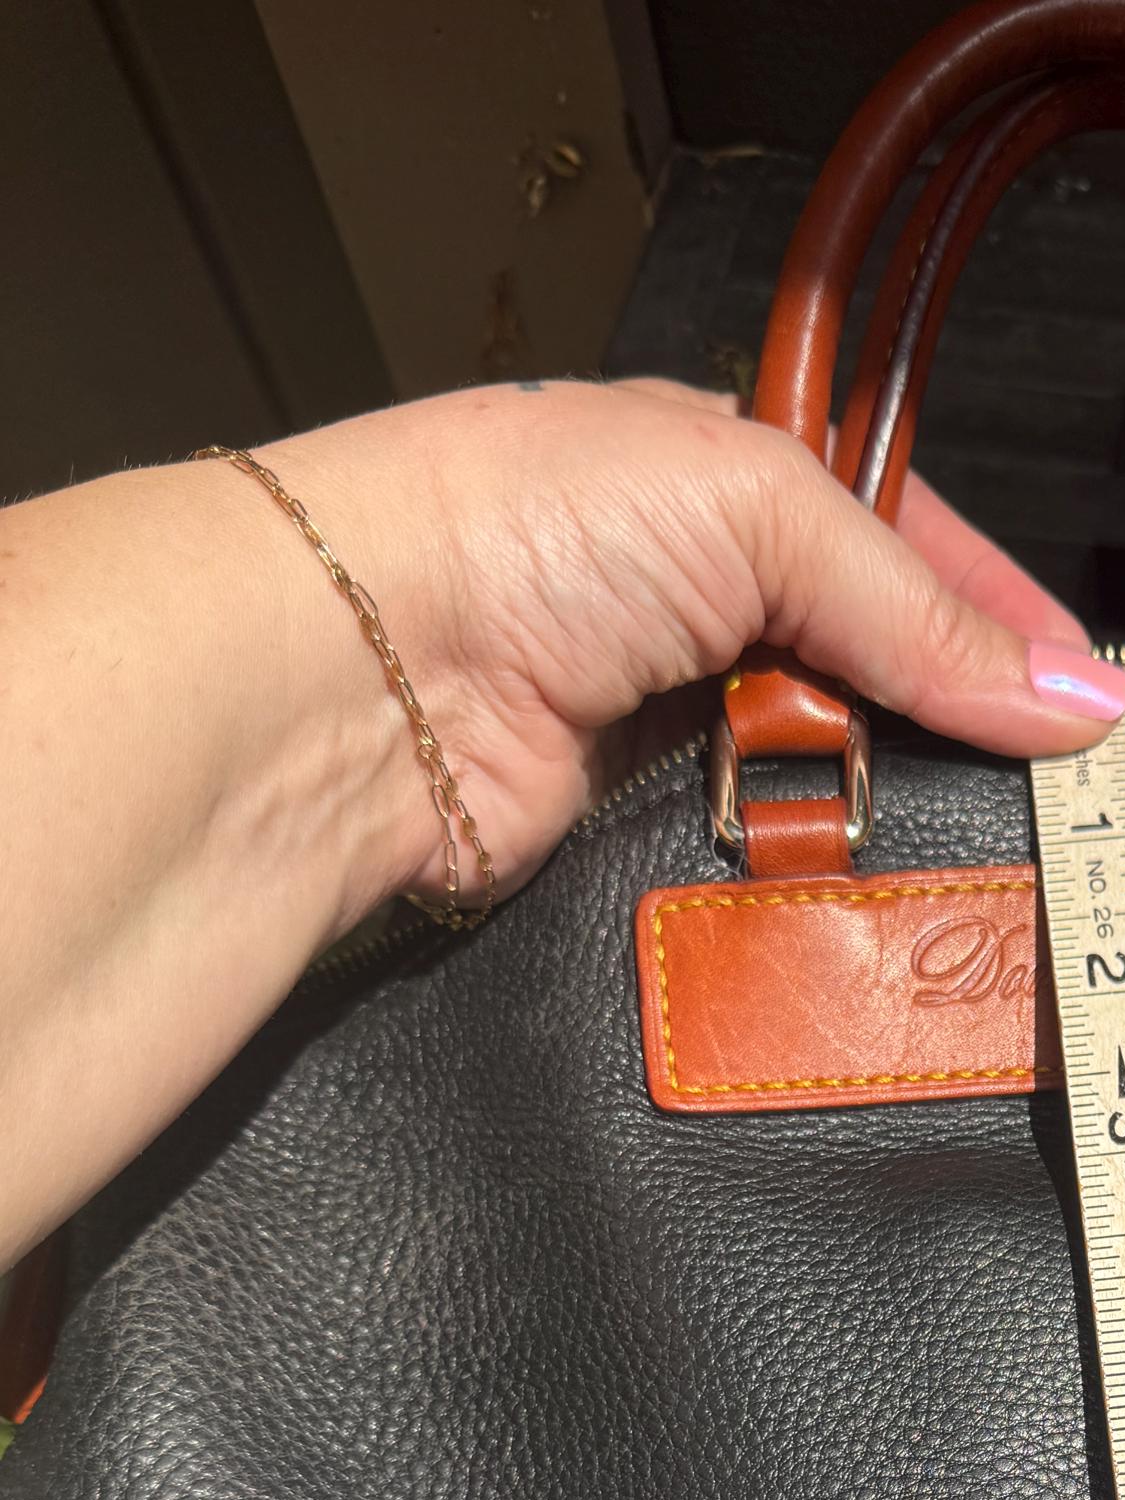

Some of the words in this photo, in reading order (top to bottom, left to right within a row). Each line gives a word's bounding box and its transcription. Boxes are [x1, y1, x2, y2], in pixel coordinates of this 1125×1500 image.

[1070, 812, 1114, 835] 1
[1085, 860, 1107, 900] NO.
[1093, 906, 1115, 940] 26
